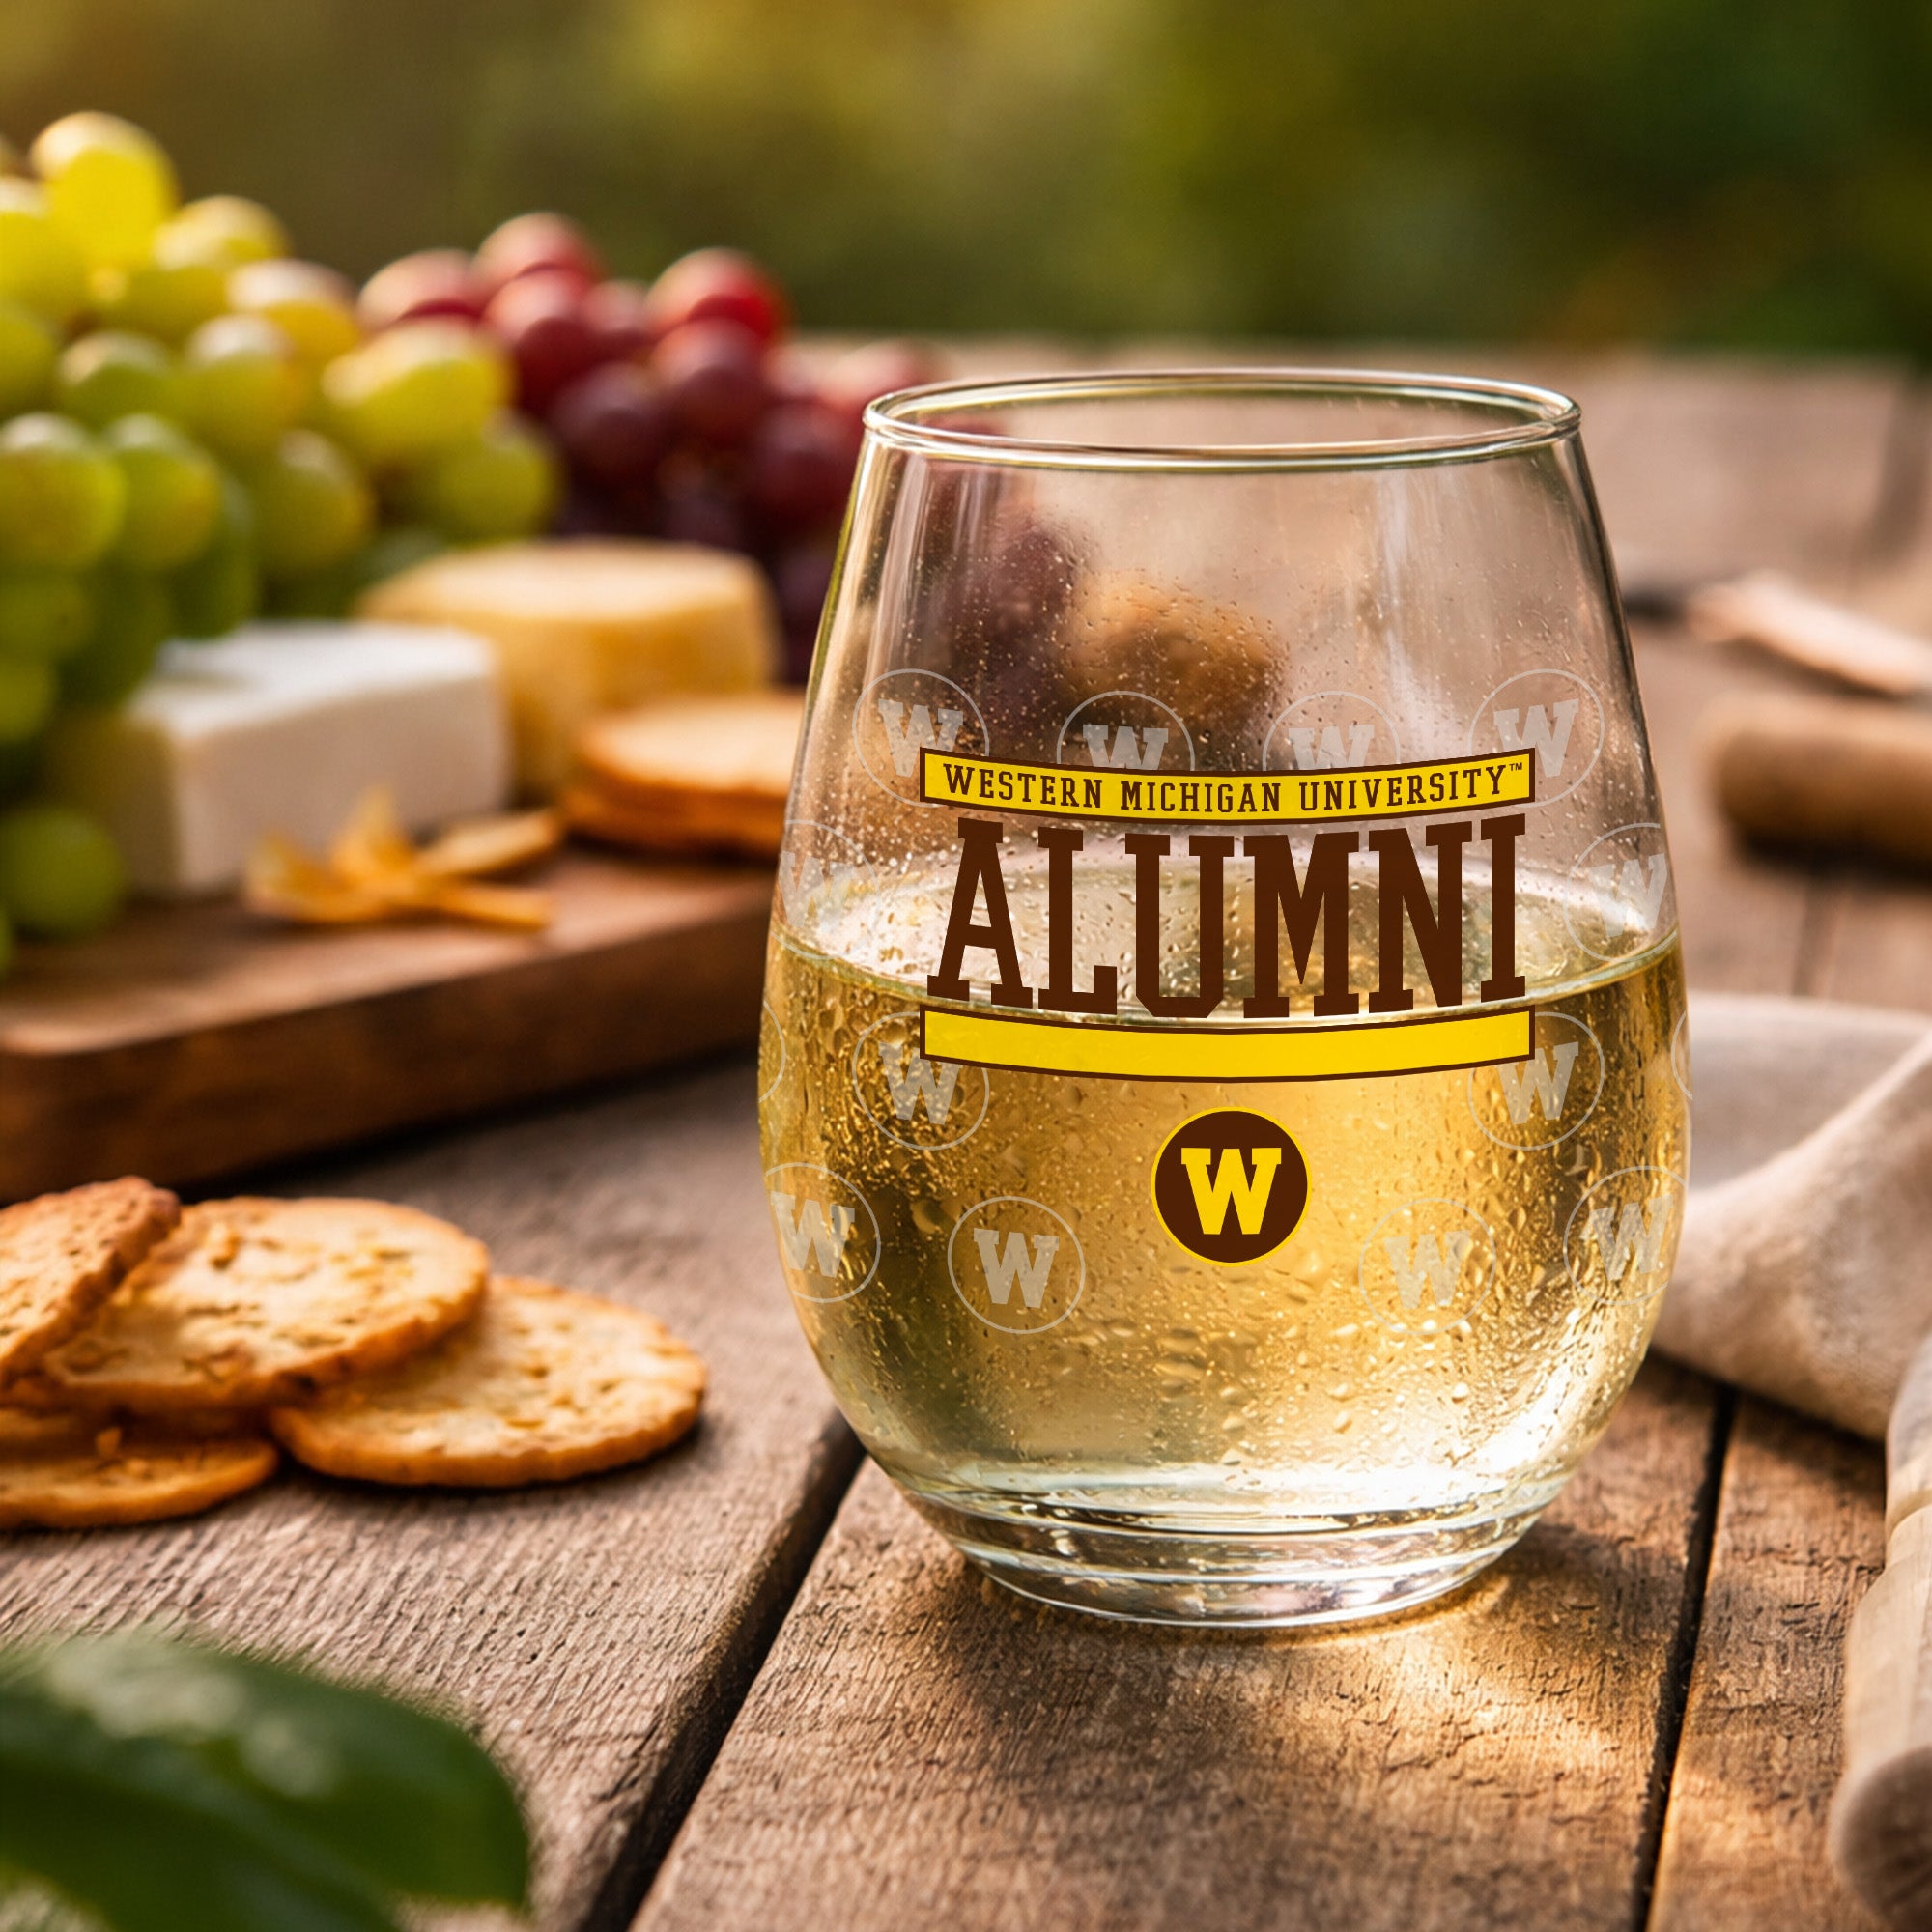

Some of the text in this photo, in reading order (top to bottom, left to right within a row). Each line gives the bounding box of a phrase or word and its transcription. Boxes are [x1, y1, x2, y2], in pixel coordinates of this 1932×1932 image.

[943, 763, 1103, 809] WESTERN
[1120, 781, 1282, 813] MICHIGAN
[927, 813, 1526, 1019] ALUMNI
[1181, 1148, 1282, 1236] W
[770, 1191, 856, 1278] W
[973, 1228, 1060, 1309] W
[1384, 1230, 1471, 1310] W
